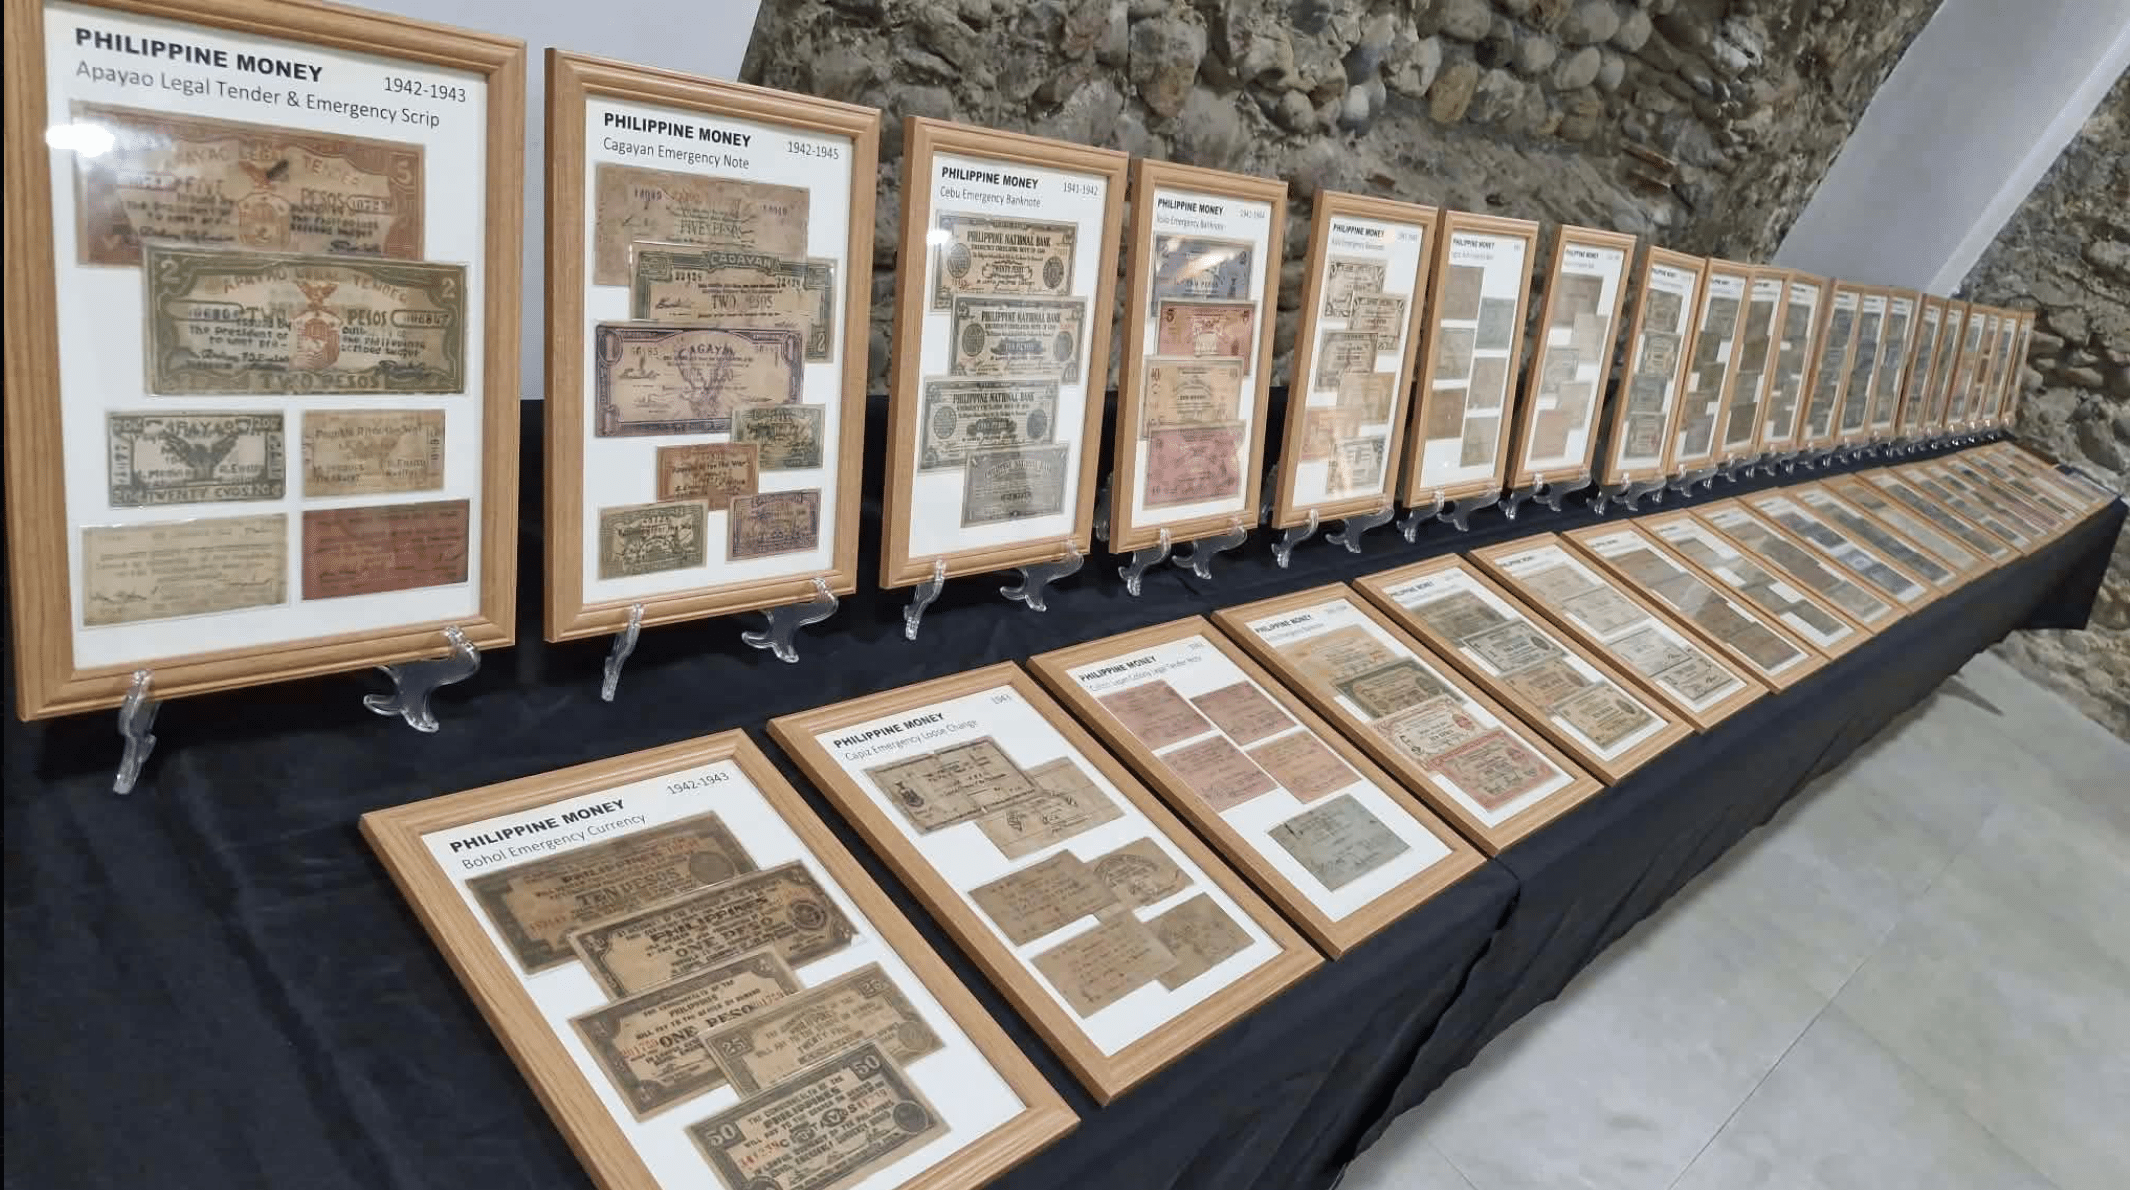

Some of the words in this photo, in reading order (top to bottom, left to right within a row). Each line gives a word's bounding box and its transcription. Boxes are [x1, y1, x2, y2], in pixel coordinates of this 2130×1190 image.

[75, 27, 228, 68] PHILIPPINE
[236, 53, 323, 82] MONEY
[75, 60, 153, 87] Apayao
[161, 72, 210, 96] Legal
[215, 80, 281, 105] Tender
[287, 90, 300, 107] &
[306, 93, 397, 123] Emergency
[401, 108, 440, 129] Scrip
[384, 76, 467, 103] 1942-1943
[603, 112, 694, 139] PHILIPPINE
[699, 127, 751, 148] MONEY
[603, 136, 654, 156] Cagayan
[657, 144, 721, 168] Emergency
[724, 154, 750, 170] Note
[787, 140, 840, 160] 1942-1945
[942, 166, 1000, 185] PHILIPPINE
[1002, 174, 1039, 190] MONEY
[940, 185, 960, 199] Cebu
[962, 188, 1004, 206] Emergency
[1006, 193, 1041, 208] Banknote
[1157, 198, 1197, 212] PHILIPPINE
[1199, 203, 1224, 215] MONEY
[967, 230, 1003, 244] PHILIPPINE
[1004, 233, 1034, 246] NATIONAL
[1036, 236, 1051, 247] BANK
[1333, 223, 1364, 236] PHILIPPINE
[1366, 229, 1384, 238] MONEY
[160, 259, 181, 284] 2
[441, 277, 456, 299] 2
[711, 294, 737, 310] TWO
[347, 308, 387, 326] PESOS
[1079, 664, 1127, 682] PHILIPPINE
[1127, 655, 1157, 668] MONEY
[833, 724, 903, 749] PHILIPPINE
[904, 712, 945, 730] MONEY
[845, 747, 873, 762] Capiz
[873, 733, 923, 755] Emergency
[945, 718, 979, 734] Change
[666, 772, 730, 795] 1942-1943
[449, 817, 559, 853] PHILIPPINE
[561, 799, 625, 825] MONEY
[462, 849, 507, 869] Bohol
[510, 829, 586, 859] Emergency
[587, 812, 647, 837] Currency
[659, 1025, 699, 1048] ONE
[705, 1003, 755, 1028] PESO
[722, 1037, 746, 1054] 25
[854, 1054, 880, 1076] 50
[706, 1122, 737, 1148] 50
